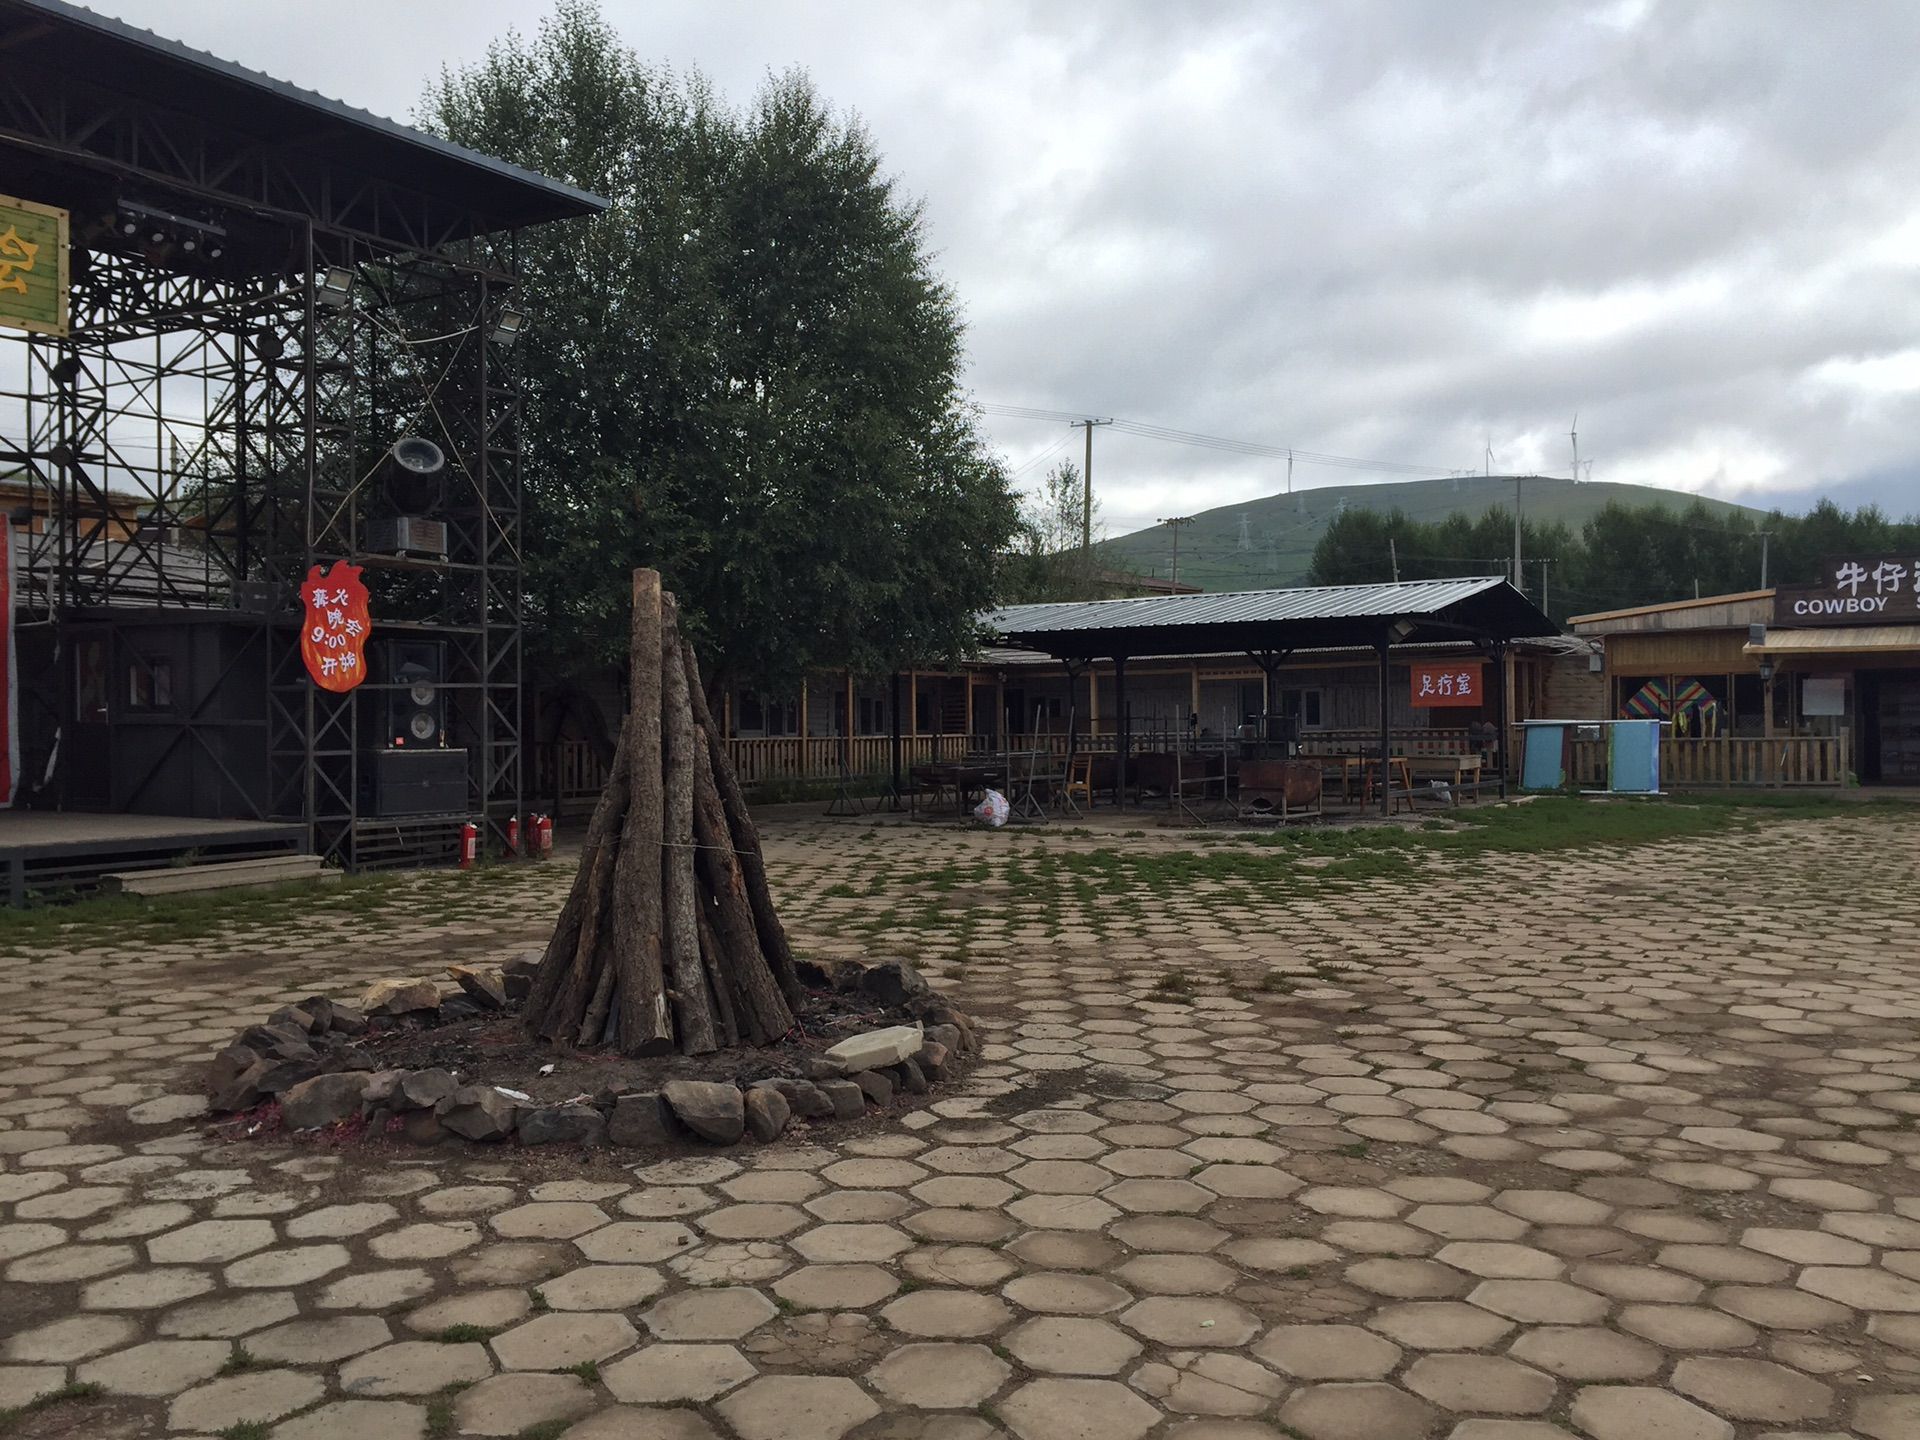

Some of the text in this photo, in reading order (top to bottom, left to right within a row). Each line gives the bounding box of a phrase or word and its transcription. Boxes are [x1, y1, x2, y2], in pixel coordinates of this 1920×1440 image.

[1835, 560, 1920, 597] 牛仔
[1793, 597, 1889, 615] COWBOY
[311, 626, 347, 649] 9:00
[320, 651, 357, 676] 开始
[1418, 672, 1472, 697] 足疗室
